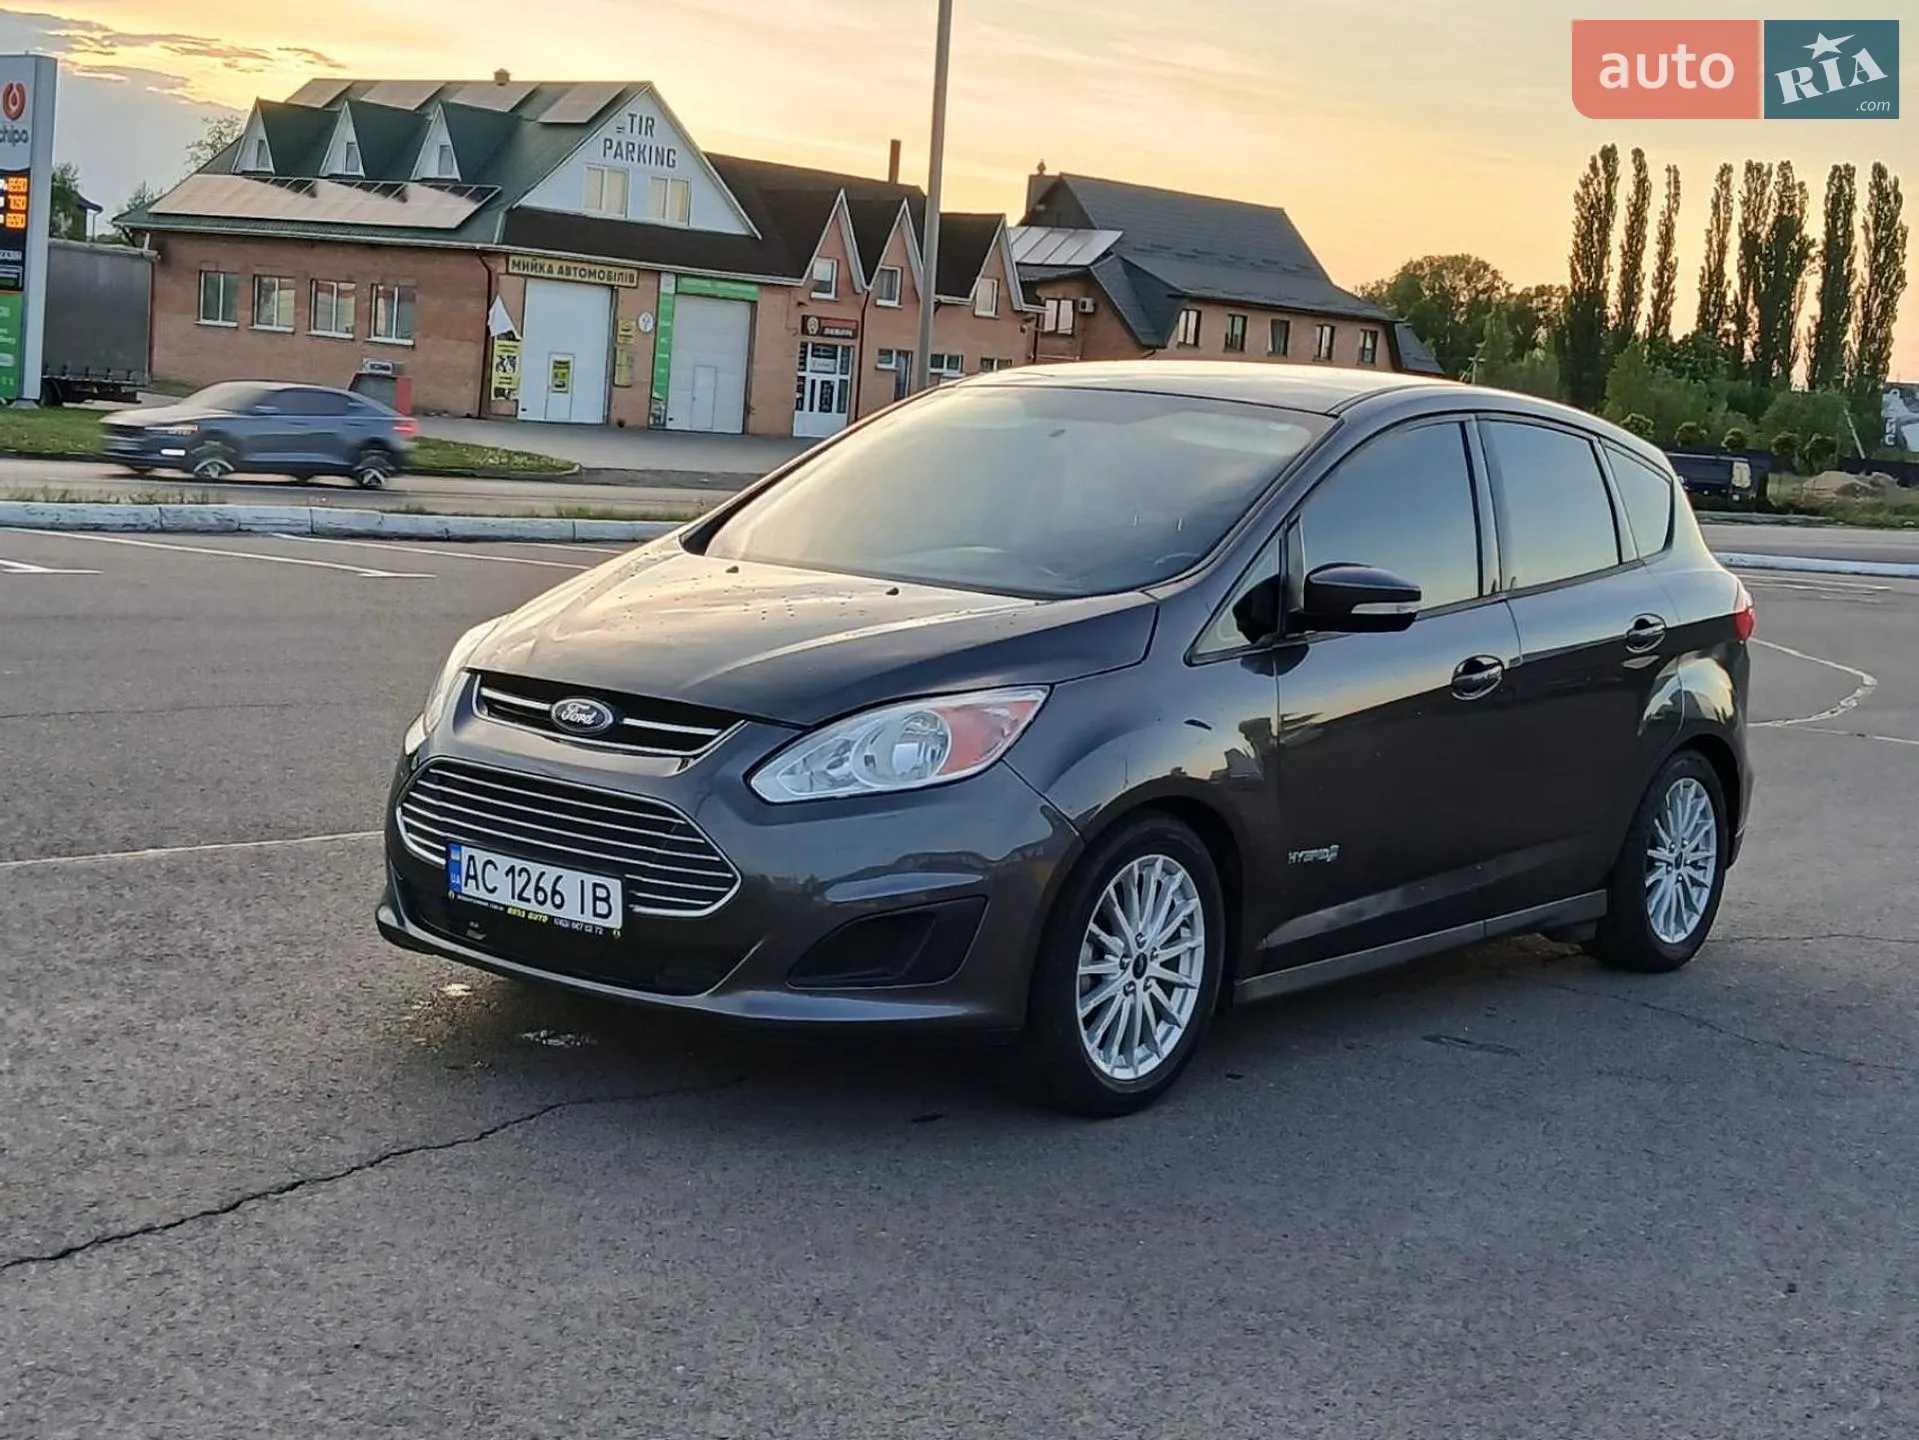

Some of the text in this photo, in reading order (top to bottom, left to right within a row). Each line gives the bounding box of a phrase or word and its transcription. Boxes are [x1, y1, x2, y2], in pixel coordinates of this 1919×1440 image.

[628, 112, 655, 138] TIR
[603, 138, 677, 168] PARKING
[511, 258, 635, 284] МИЙКА АВТОМОБІЛІВ
[561, 702, 597, 724] Ford
